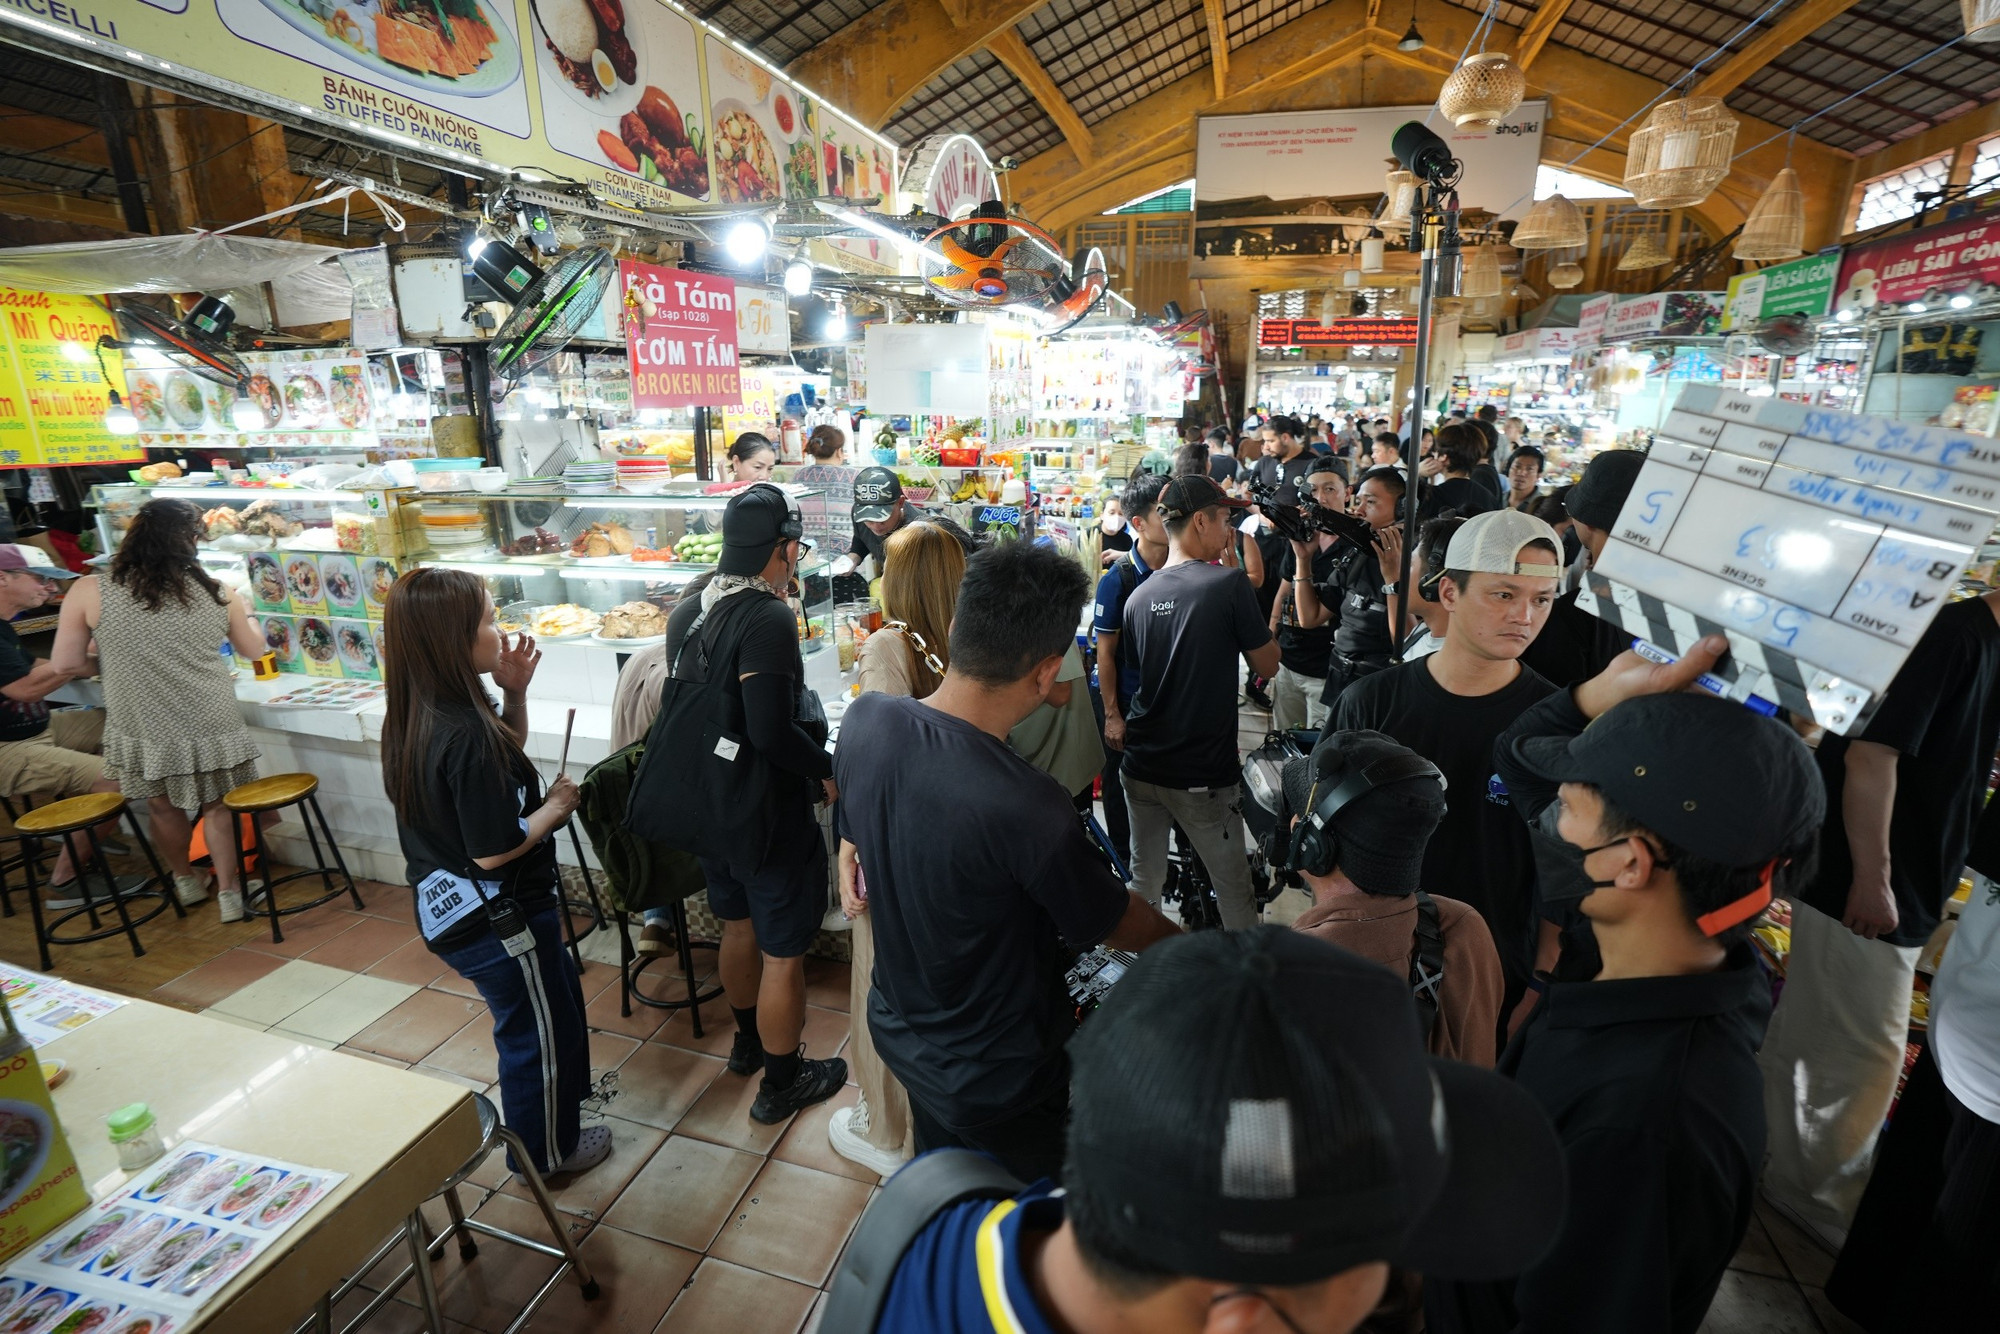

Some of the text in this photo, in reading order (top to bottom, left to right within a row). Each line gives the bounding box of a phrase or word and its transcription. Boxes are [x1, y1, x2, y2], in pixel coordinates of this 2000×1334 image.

[5, 0, 118, 40] CELLI
[323, 76, 377, 107] BÁNH
[435, 116, 478, 140] NÓNG
[323, 94, 483, 157] STUFFED PANCAKE
[1496, 121, 1539, 136] shojiki
[586, 177, 647, 207] VIETNAMESE
[652, 189, 672, 202] NAM
[934, 155, 959, 219] KHU
[0, 287, 51, 310] ành
[675, 280, 732, 312] Tám
[10, 312, 39, 340] Mì
[683, 310, 710, 324] 1028)
[636, 334, 735, 367] CƠM TẤM
[637, 372, 738, 396] BROKEN RICE
[1725, 401, 1752, 414] DAY
[1698, 427, 1718, 437] FPS
[1758, 440, 1777, 451] ISO
[1737, 465, 1766, 479] LENS
[1639, 490, 1674, 524] 5
[1947, 518, 1974, 532] DIR
[1623, 529, 1651, 546] TAKE
[1720, 564, 1767, 588] SCENE
[1927, 561, 1956, 580] B
[1909, 592, 1935, 610] A
[1851, 612, 1898, 636] CARD
[431, 891, 463, 920] CLUB
[0, 1163, 78, 1220] spaghetti
